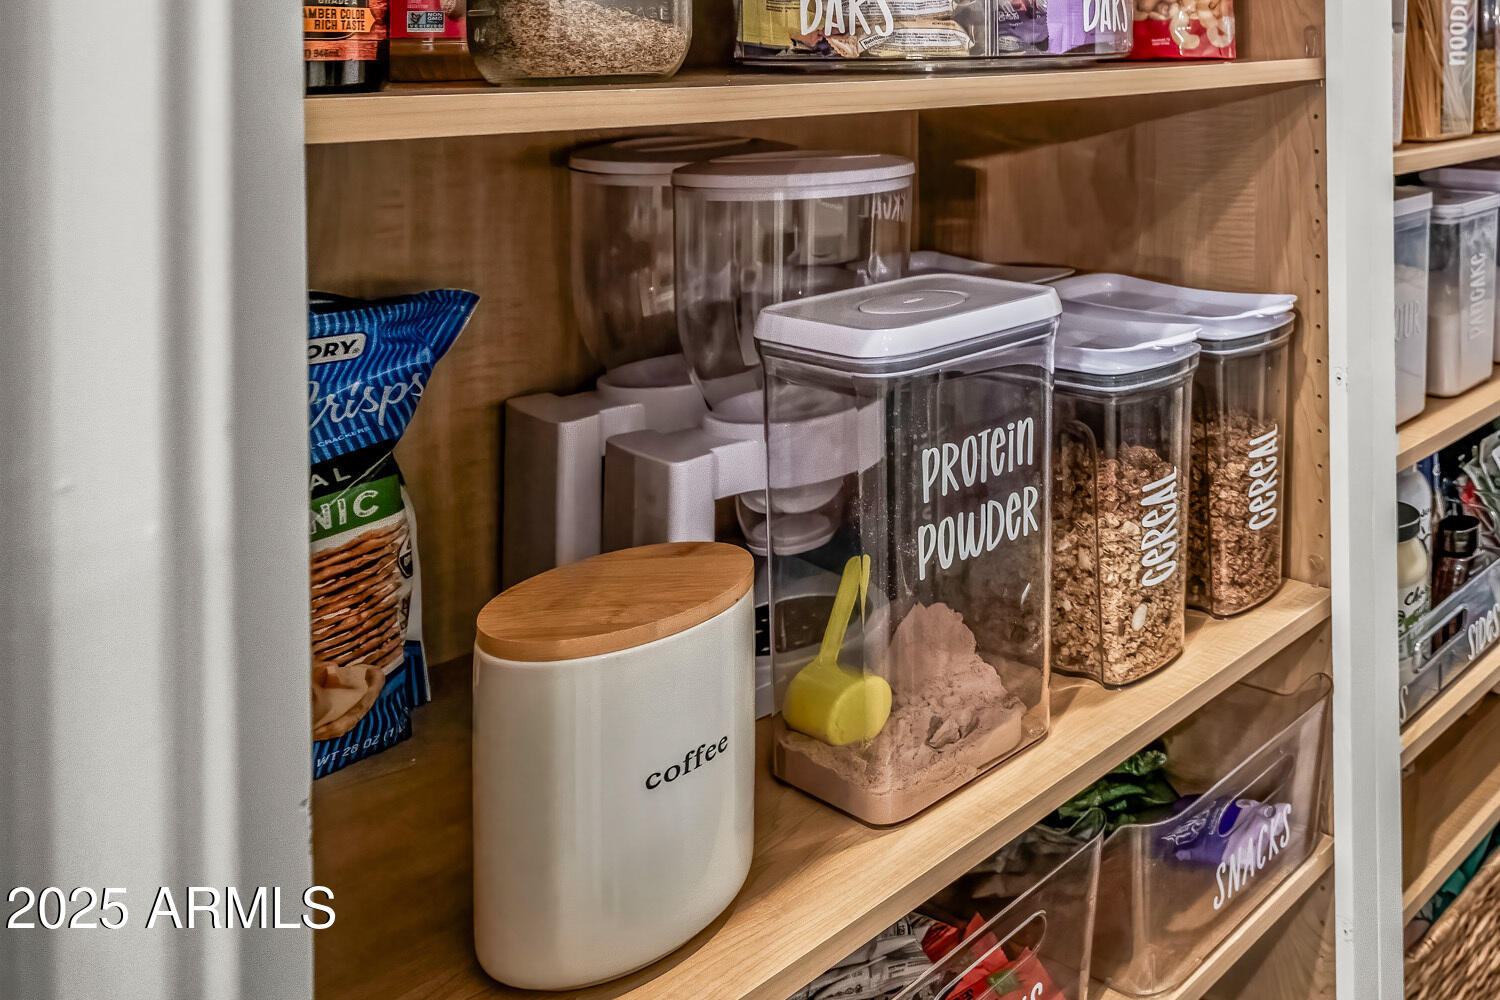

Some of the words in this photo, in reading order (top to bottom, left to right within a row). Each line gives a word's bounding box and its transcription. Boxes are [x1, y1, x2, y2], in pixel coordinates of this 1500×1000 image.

[314, 19, 338, 31] RICH
[341, 19, 366, 31] TASTE
[340, 8, 365, 20] COLOR
[317, 425, 371, 448] CRACKERS
[317, 748, 339, 769] WT
[362, 734, 380, 751] OZ
[645, 735, 729, 790] coffee
[1213, 803, 1293, 911] SNACKS
